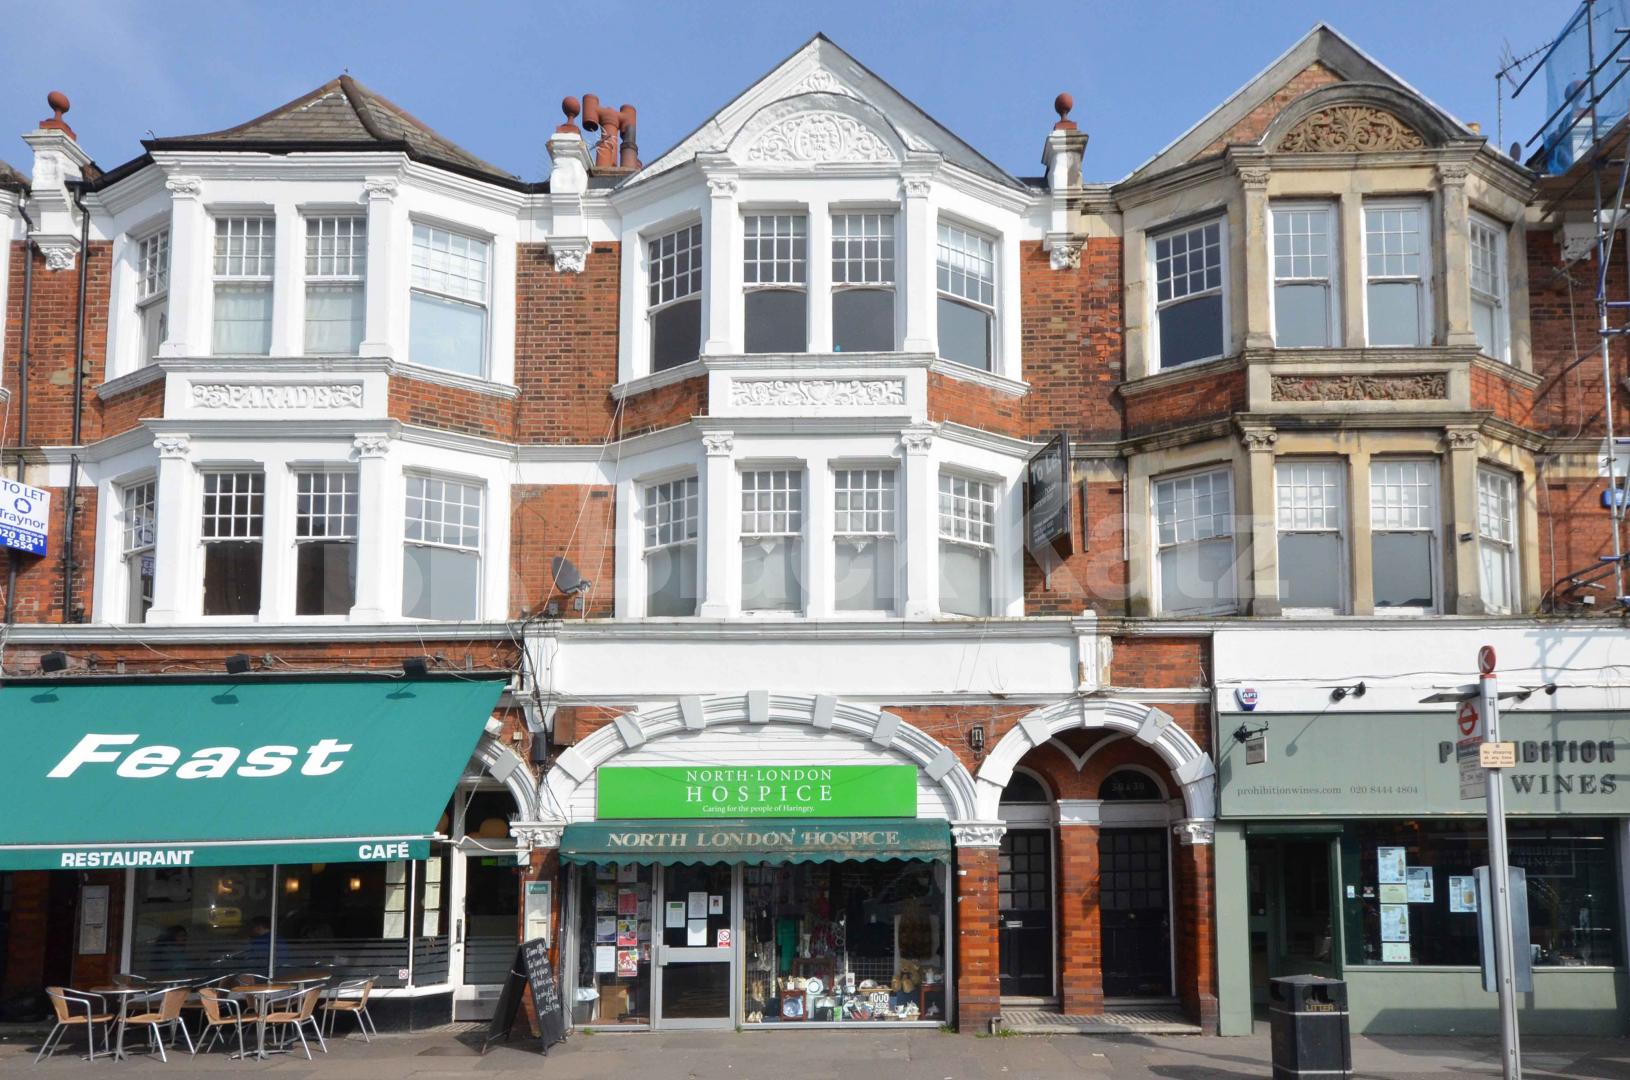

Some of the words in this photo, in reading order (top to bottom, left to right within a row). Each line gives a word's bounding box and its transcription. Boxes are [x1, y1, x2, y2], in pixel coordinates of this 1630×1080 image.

[2, 480, 20, 494] TO
[24, 487, 46, 501] LET
[6, 538, 33, 551] 5554
[19, 532, 44, 547] 8341
[1479, 649, 1491, 672] K
[46, 733, 353, 780] Feast
[1237, 785, 1342, 796] prohibitionwines.com
[1350, 785, 1368, 794] 020
[1510, 773, 1617, 794] WINES
[686, 785, 832, 802] HOSPICE
[702, 805, 726, 814] Caring
[727, 805, 737, 813] for
[738, 805, 750, 813] the
[750, 805, 773, 814] people
[774, 805, 782, 813] of
[607, 833, 688, 847] NORTH
[696, 831, 795, 847] LONDON
[804, 831, 900, 845] HOSPICE
[61, 849, 194, 868] RESTAURANT
[358, 841, 410, 860] CAFÉ
[1306, 1004, 1334, 1012] LITTER
